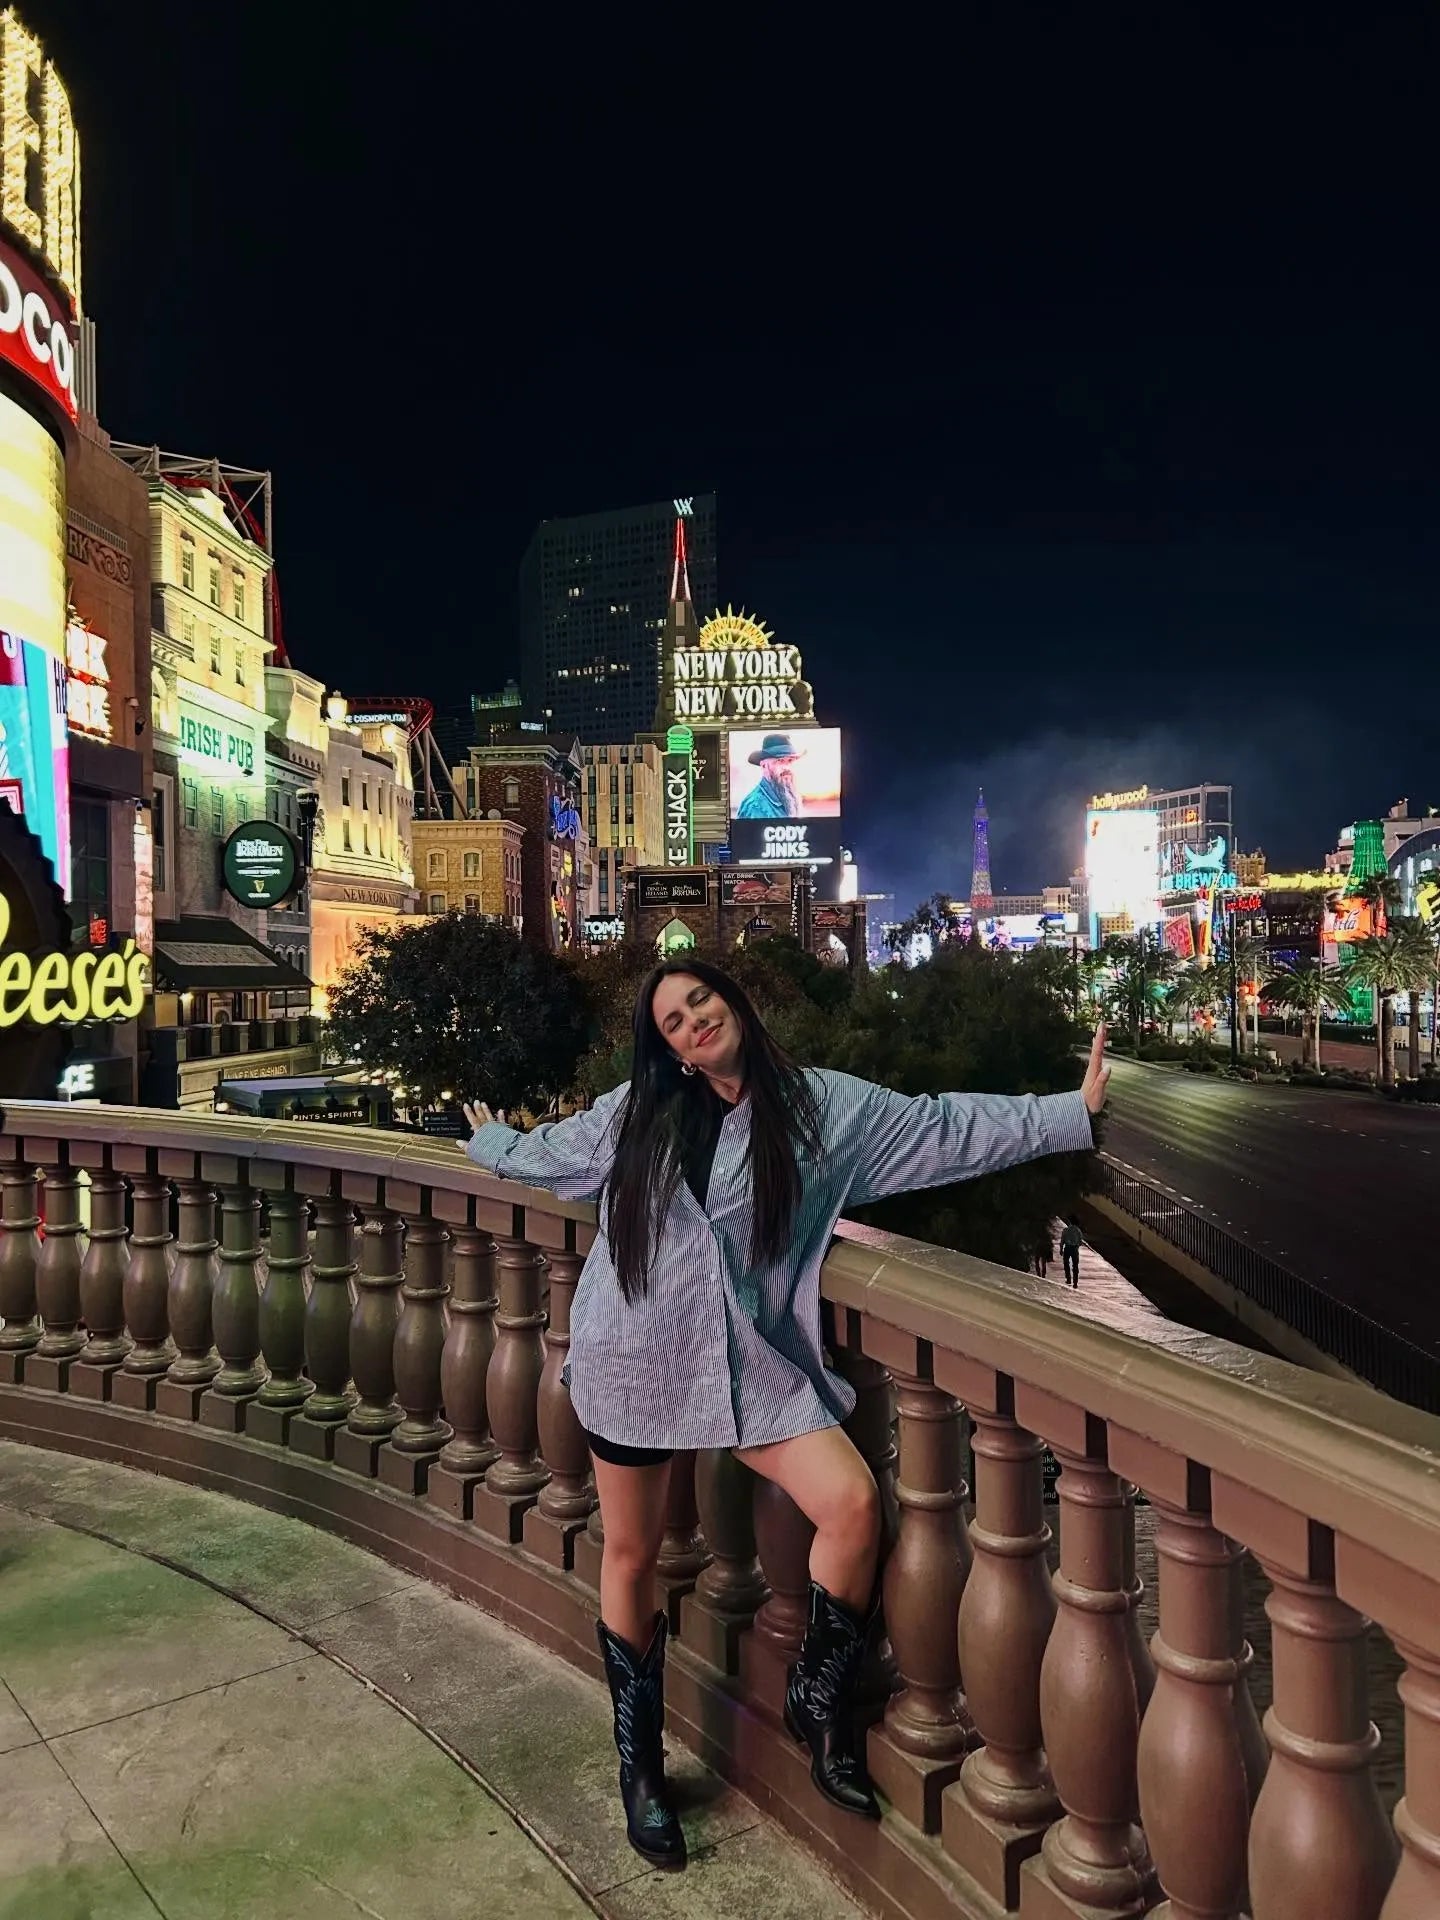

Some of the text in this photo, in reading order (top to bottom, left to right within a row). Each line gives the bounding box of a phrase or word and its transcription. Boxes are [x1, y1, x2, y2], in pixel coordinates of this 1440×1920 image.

[673, 650, 796, 679] NEW YORK
[673, 685, 796, 716] NEW YORK
[180, 715, 255, 769] IRISH PUB
[667, 769, 688, 840] SHACK
[1092, 785, 1148, 811] hollywood
[763, 825, 808, 842] CODY
[761, 842, 810, 858] JINKS
[1174, 871, 1238, 890] BREWOG
[343, 887, 366, 902] NEW
[292, 1110, 364, 1121] PINTS SPIRITS
